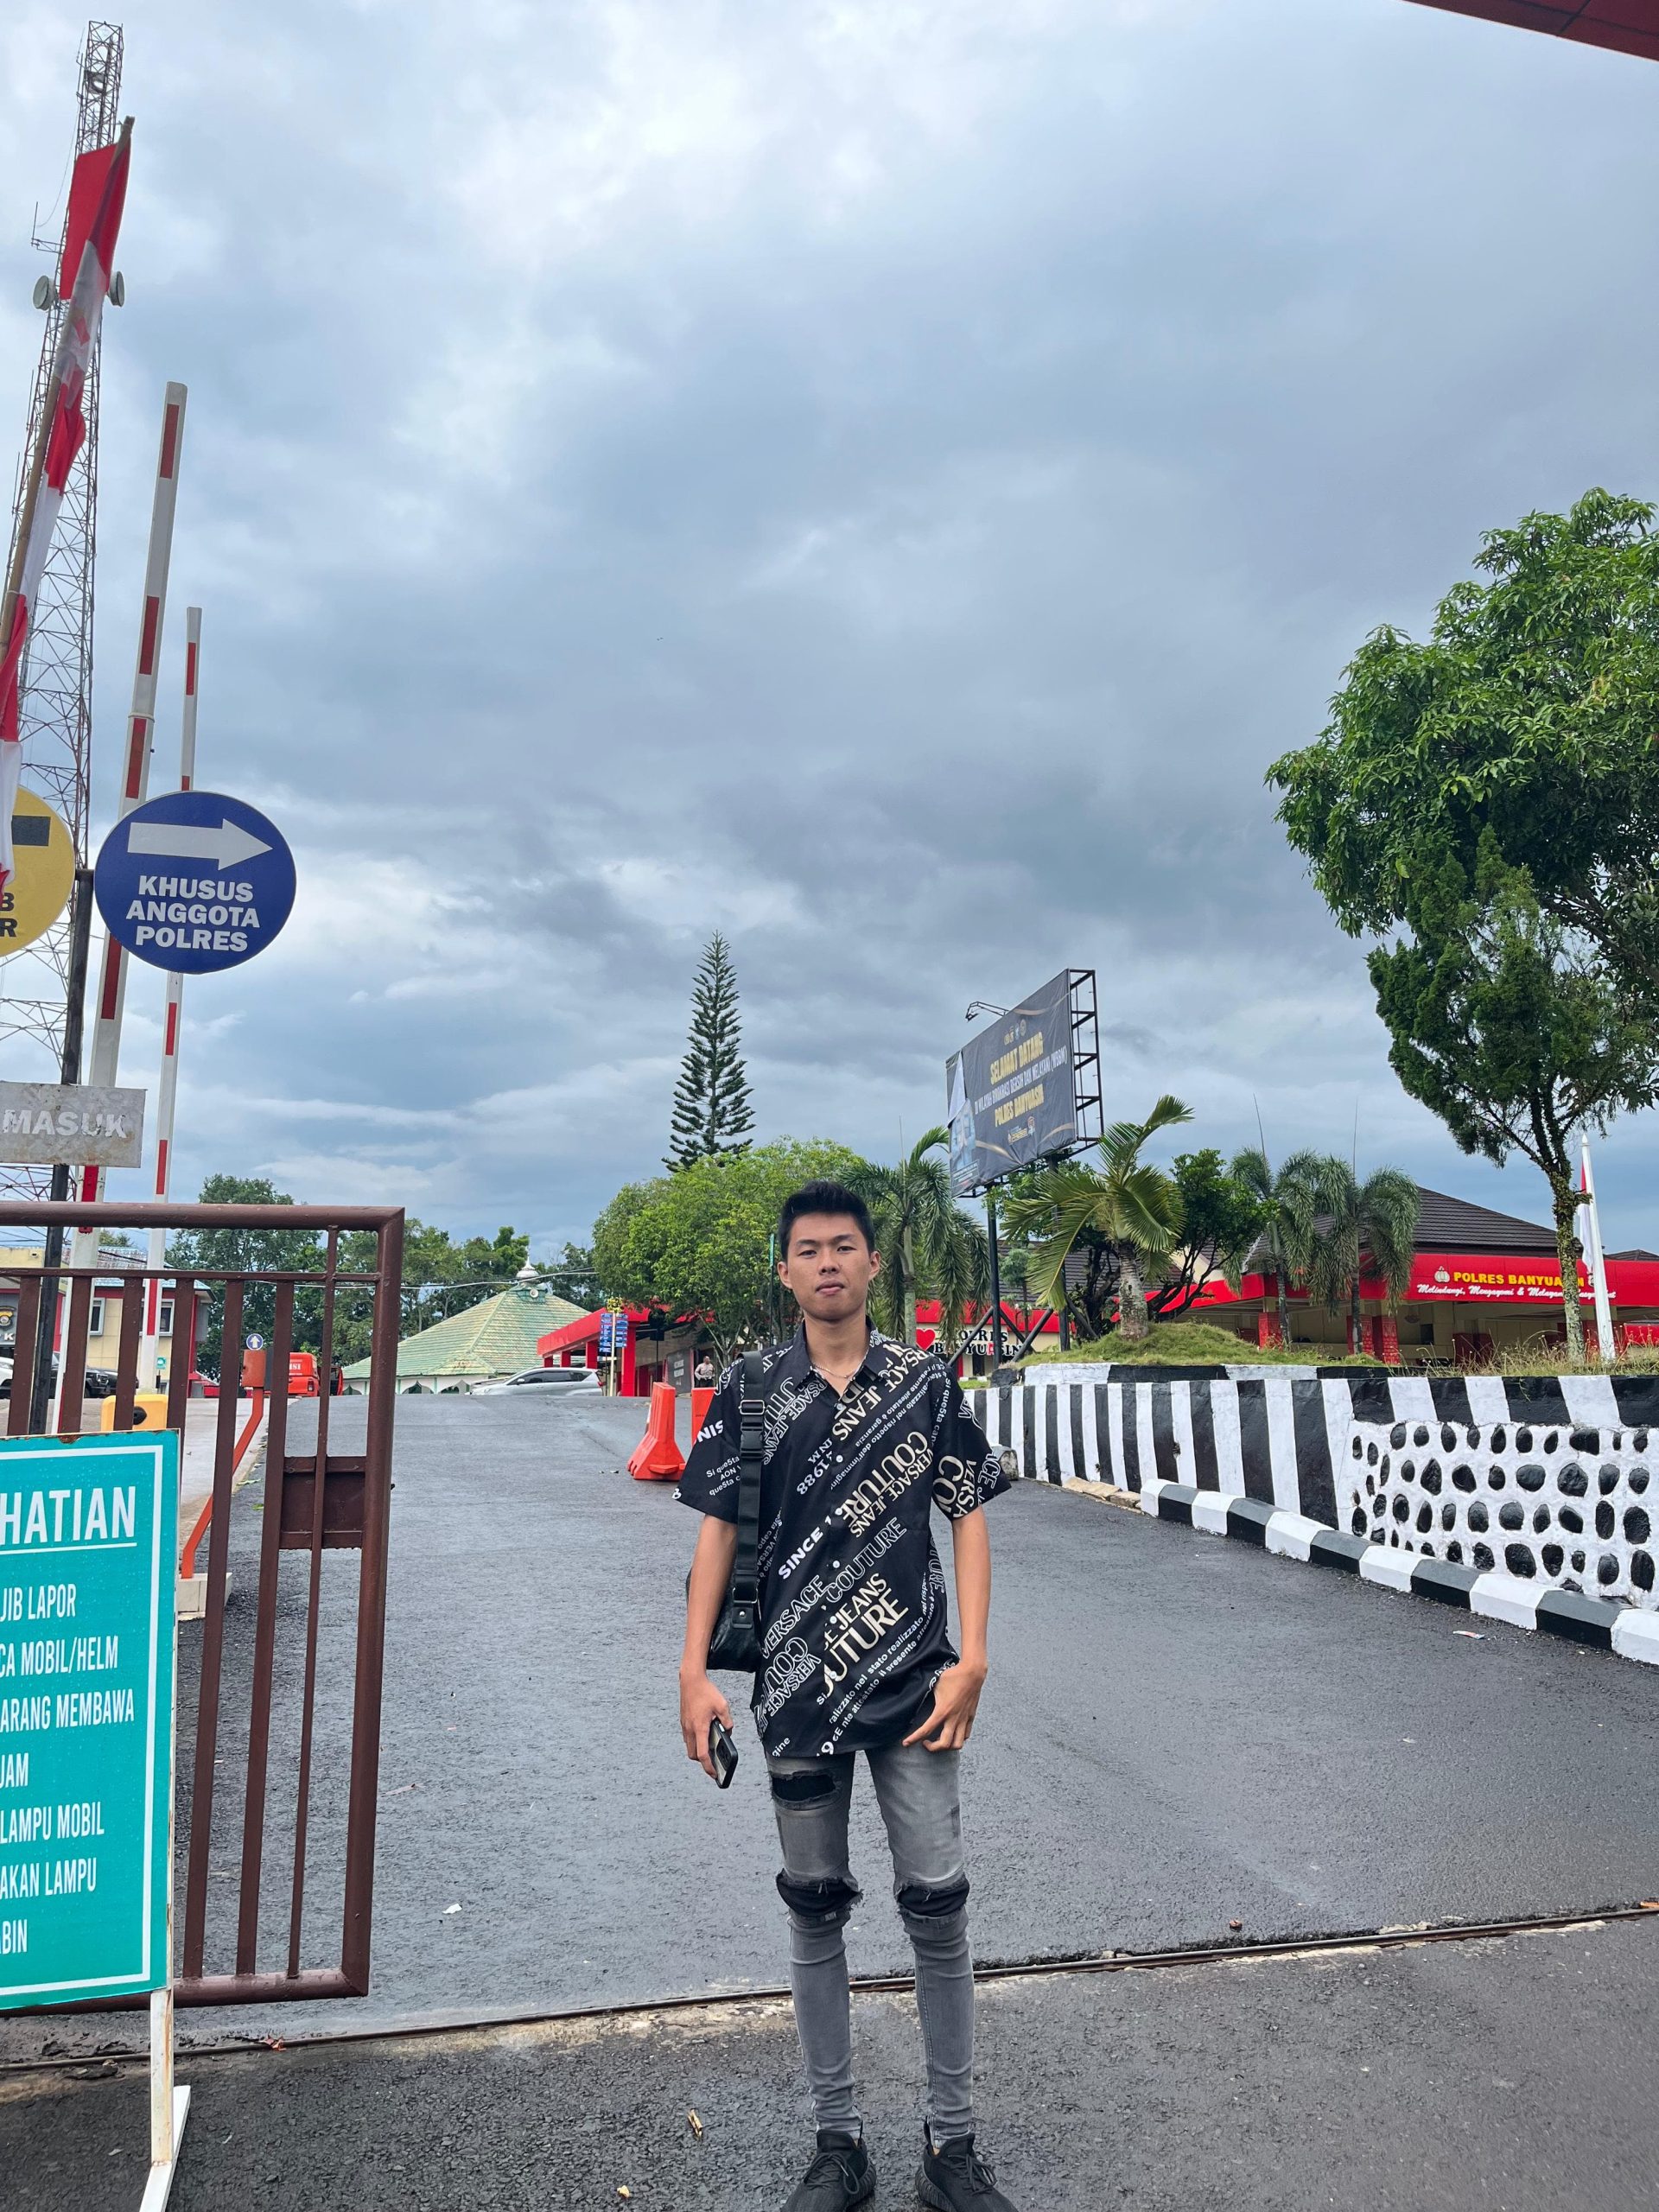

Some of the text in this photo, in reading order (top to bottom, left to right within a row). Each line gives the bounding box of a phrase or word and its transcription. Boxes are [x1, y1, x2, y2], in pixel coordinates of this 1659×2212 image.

[138, 874, 254, 903] KHUSUS
[125, 899, 261, 928] ANGGOTA
[136, 925, 249, 952] POLRES
[3, 1109, 127, 1139] MASUK
[1453, 1272, 1504, 1284] POLRES
[832, 1385, 882, 1441] JEANS
[855, 1418, 882, 1447] garanzia
[797, 1459, 830, 1496] 1988
[842, 1431, 929, 1528] COUTURE
[0, 1485, 136, 1546] HATIAN
[849, 1496, 887, 1538] JEANS
[779, 1526, 823, 1580] SINCE
[825, 1516, 907, 1603] COUTURE
[28, 1583, 77, 1620] LAPOR
[761, 1574, 825, 1659] VERSACE
[836, 1573, 887, 1631] JEANS
[21, 1635, 118, 1676] MOBIL/HELM
[0, 1688, 135, 1733] ARANG MEMBAWA
[0, 1802, 105, 1845] LAMPU MOBIL
[0, 1857, 97, 1899] AKAN LAMPU
